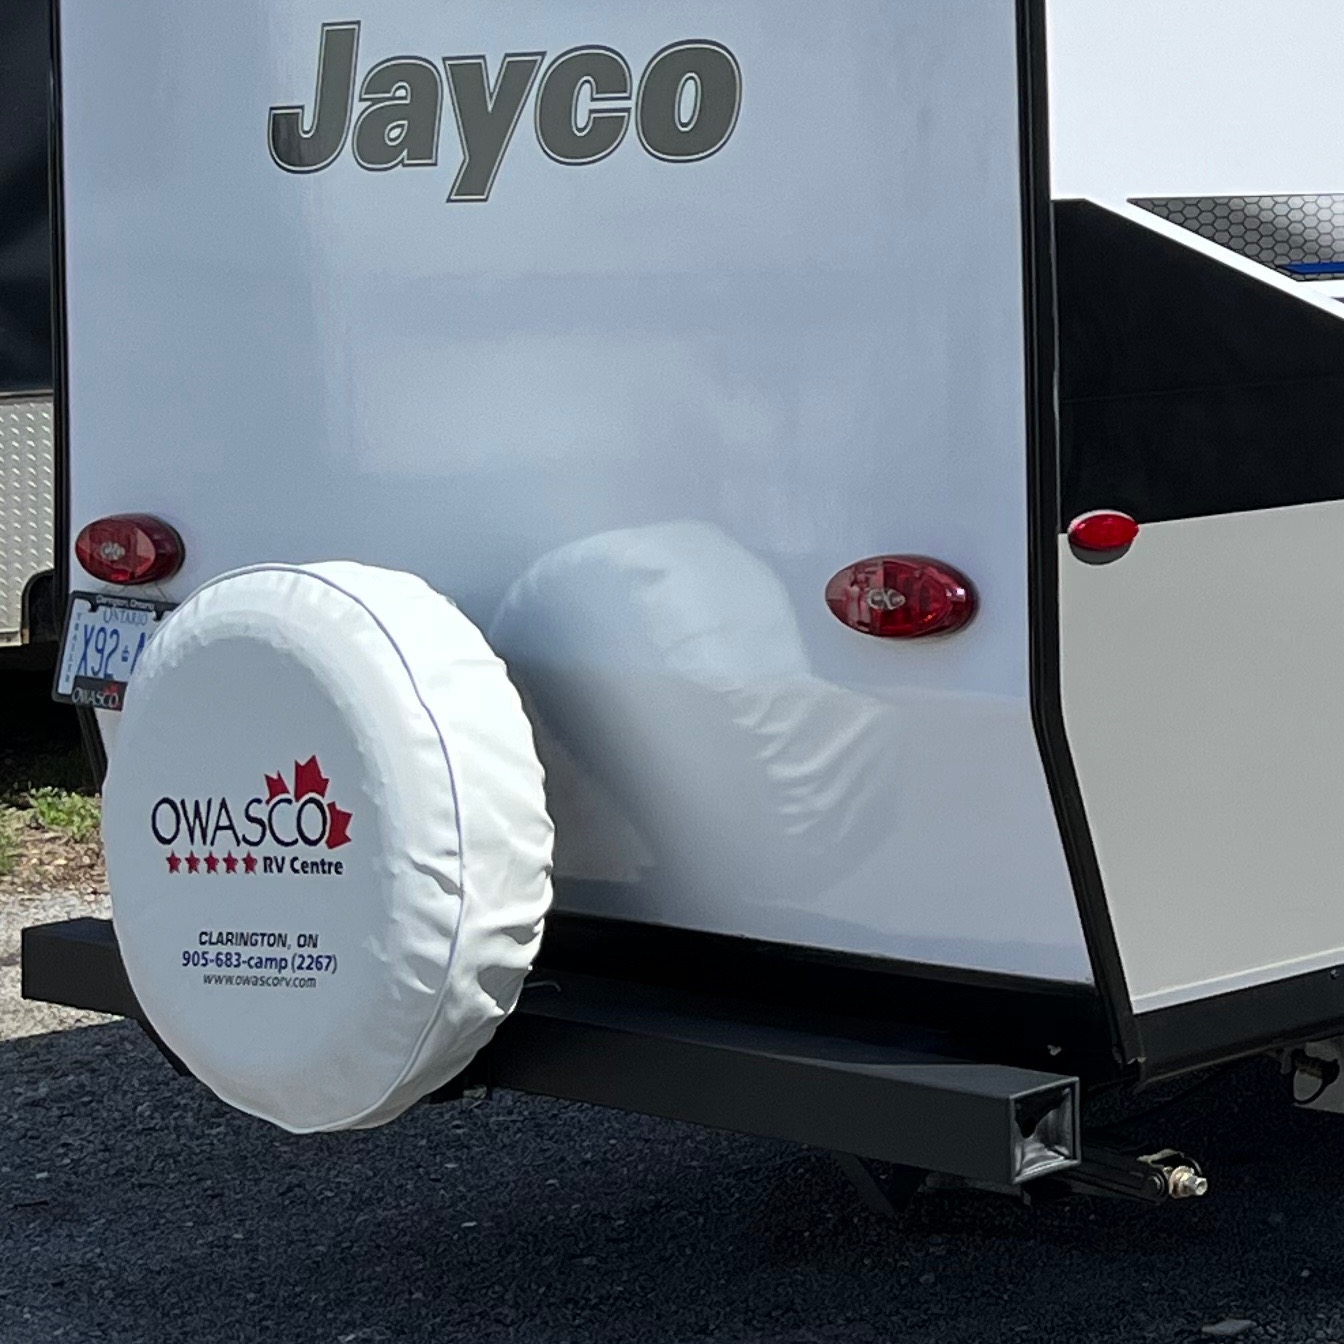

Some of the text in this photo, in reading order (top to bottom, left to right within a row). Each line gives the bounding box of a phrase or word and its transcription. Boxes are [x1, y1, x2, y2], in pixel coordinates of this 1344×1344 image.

[268, 20, 742, 202] Jayco
[151, 796, 328, 847] OWASCO
[262, 856, 344, 876] RV Centre
[198, 930, 319, 951] CLARINGTON, ON
[181, 950, 338, 975] 905-683-camp (2267)
